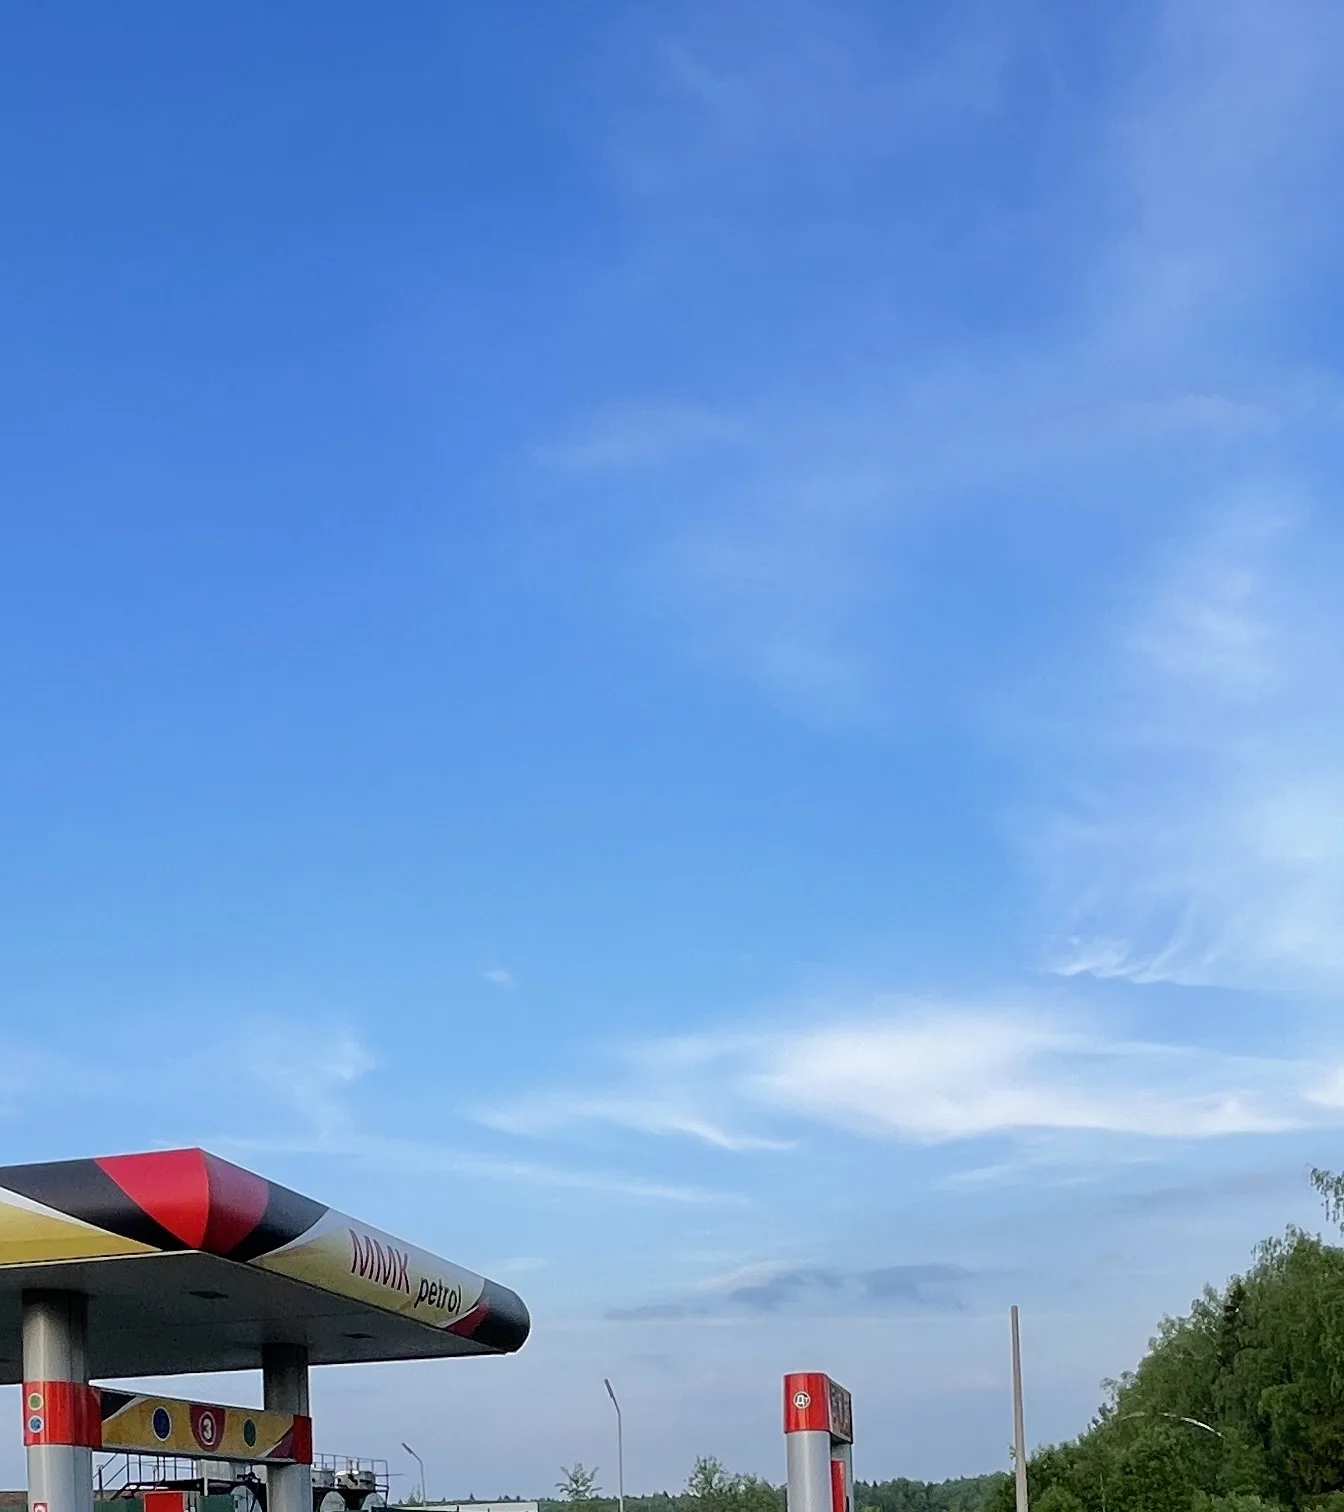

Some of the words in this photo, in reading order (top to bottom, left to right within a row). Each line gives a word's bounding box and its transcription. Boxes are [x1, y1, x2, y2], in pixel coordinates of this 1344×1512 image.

[348, 1228, 411, 1295] MMK
[413, 1276, 462, 1316] petrol
[202, 1418, 212, 1440] 3
